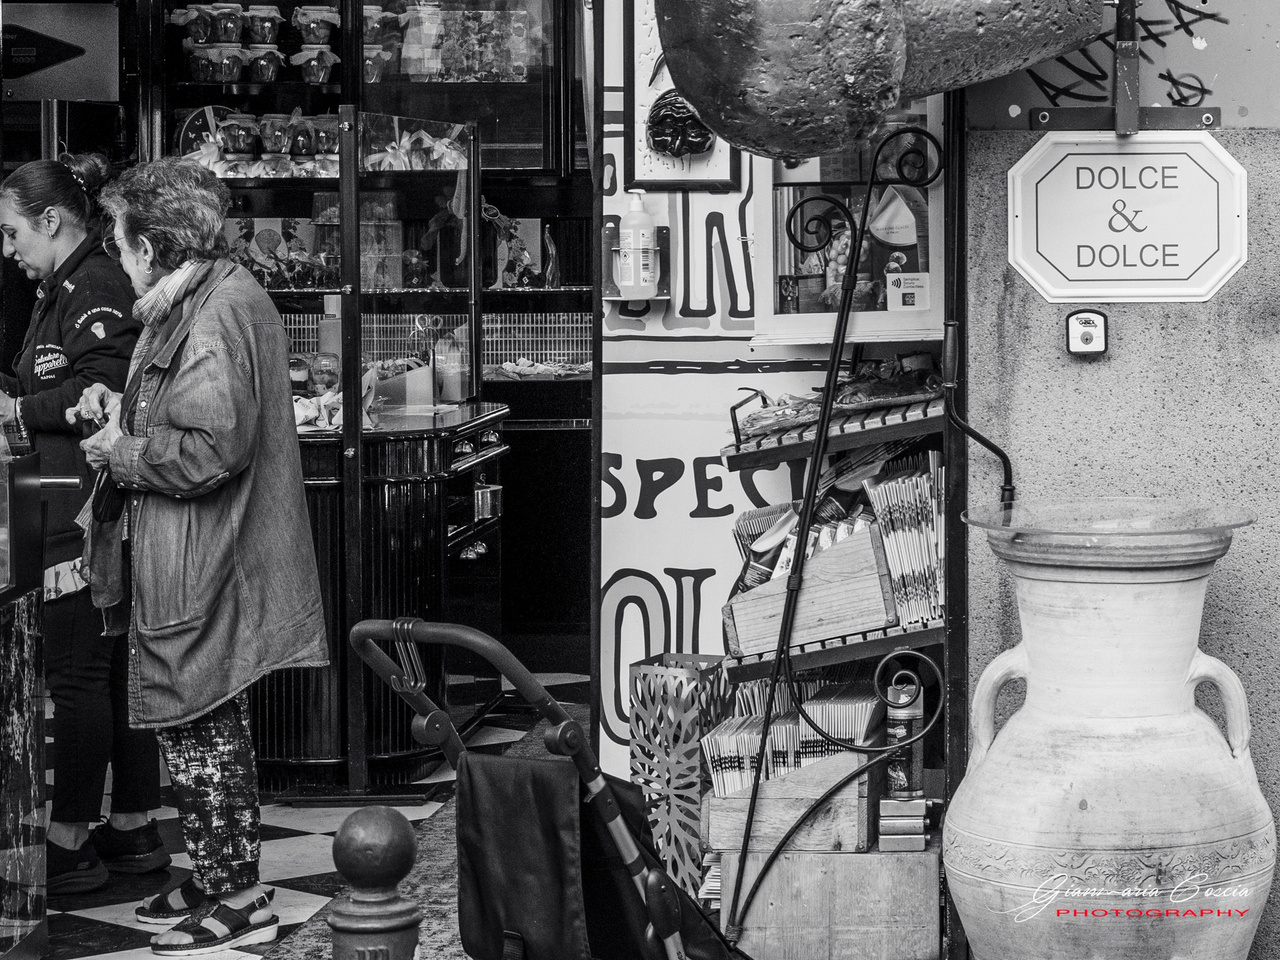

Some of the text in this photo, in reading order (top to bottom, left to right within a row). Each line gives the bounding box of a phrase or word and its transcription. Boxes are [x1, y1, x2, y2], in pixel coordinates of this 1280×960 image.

[1076, 166, 1179, 190] DOLCE
[1108, 199, 1148, 233] &
[1077, 244, 1180, 268] DOLCE
[34, 354, 68, 377] apparelli
